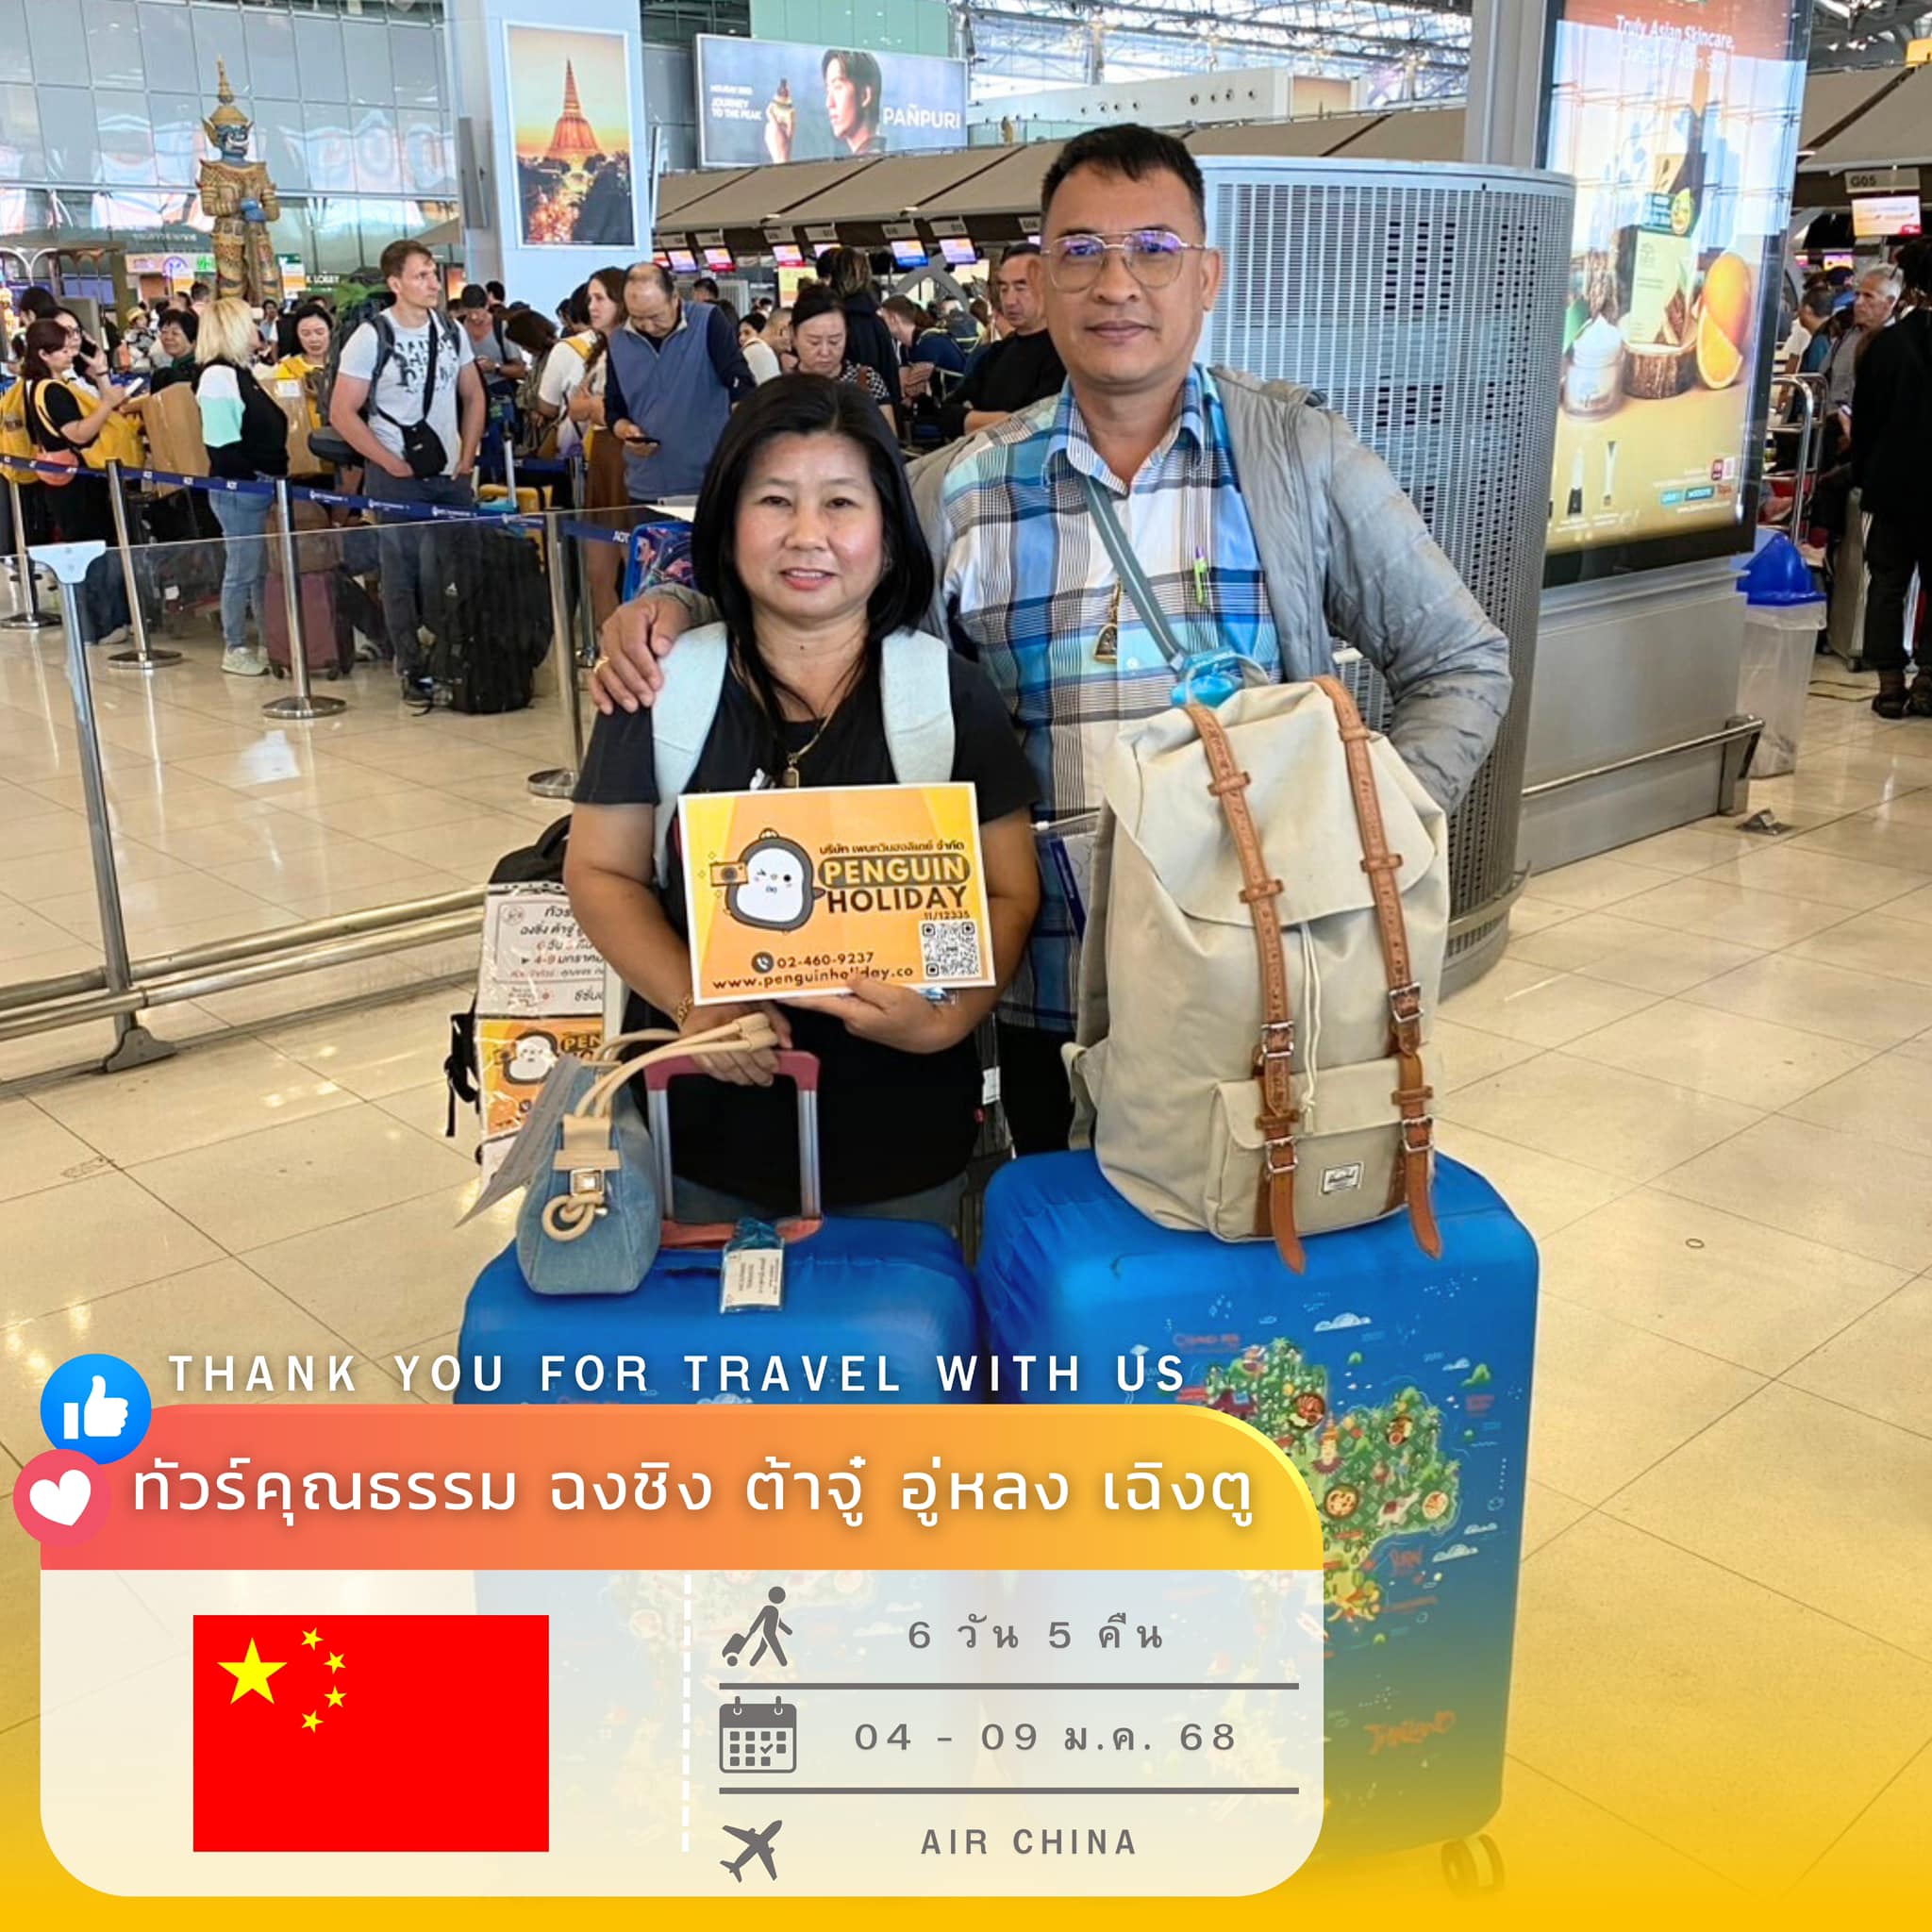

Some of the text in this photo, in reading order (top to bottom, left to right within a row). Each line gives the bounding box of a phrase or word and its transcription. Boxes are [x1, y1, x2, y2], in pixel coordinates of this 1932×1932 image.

[883, 103, 960, 129] PAÑPURI
[1851, 175, 1877, 188] G05
[823, 856, 966, 885] PENGUIN
[826, 885, 967, 913] HOLIDAY
[776, 951, 874, 969] 02-460-9237
